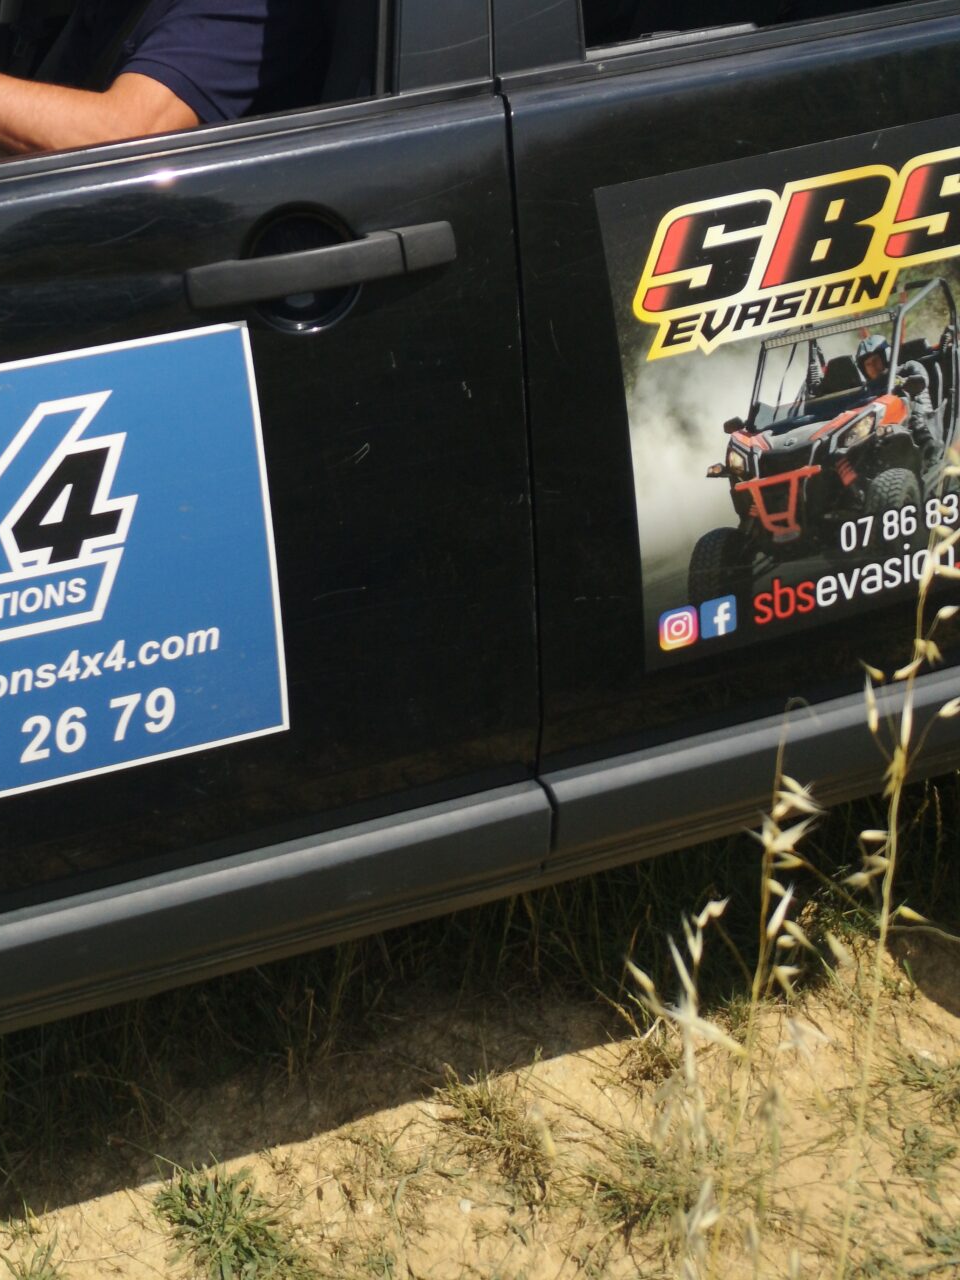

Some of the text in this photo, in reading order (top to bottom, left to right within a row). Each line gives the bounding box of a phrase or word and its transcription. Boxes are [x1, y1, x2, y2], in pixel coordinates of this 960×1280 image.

[661, 271, 890, 348] EVASION
[840, 493, 959, 553] 07 86 83
[19, 706, 88, 764] 26
[109, 686, 177, 742] 79
